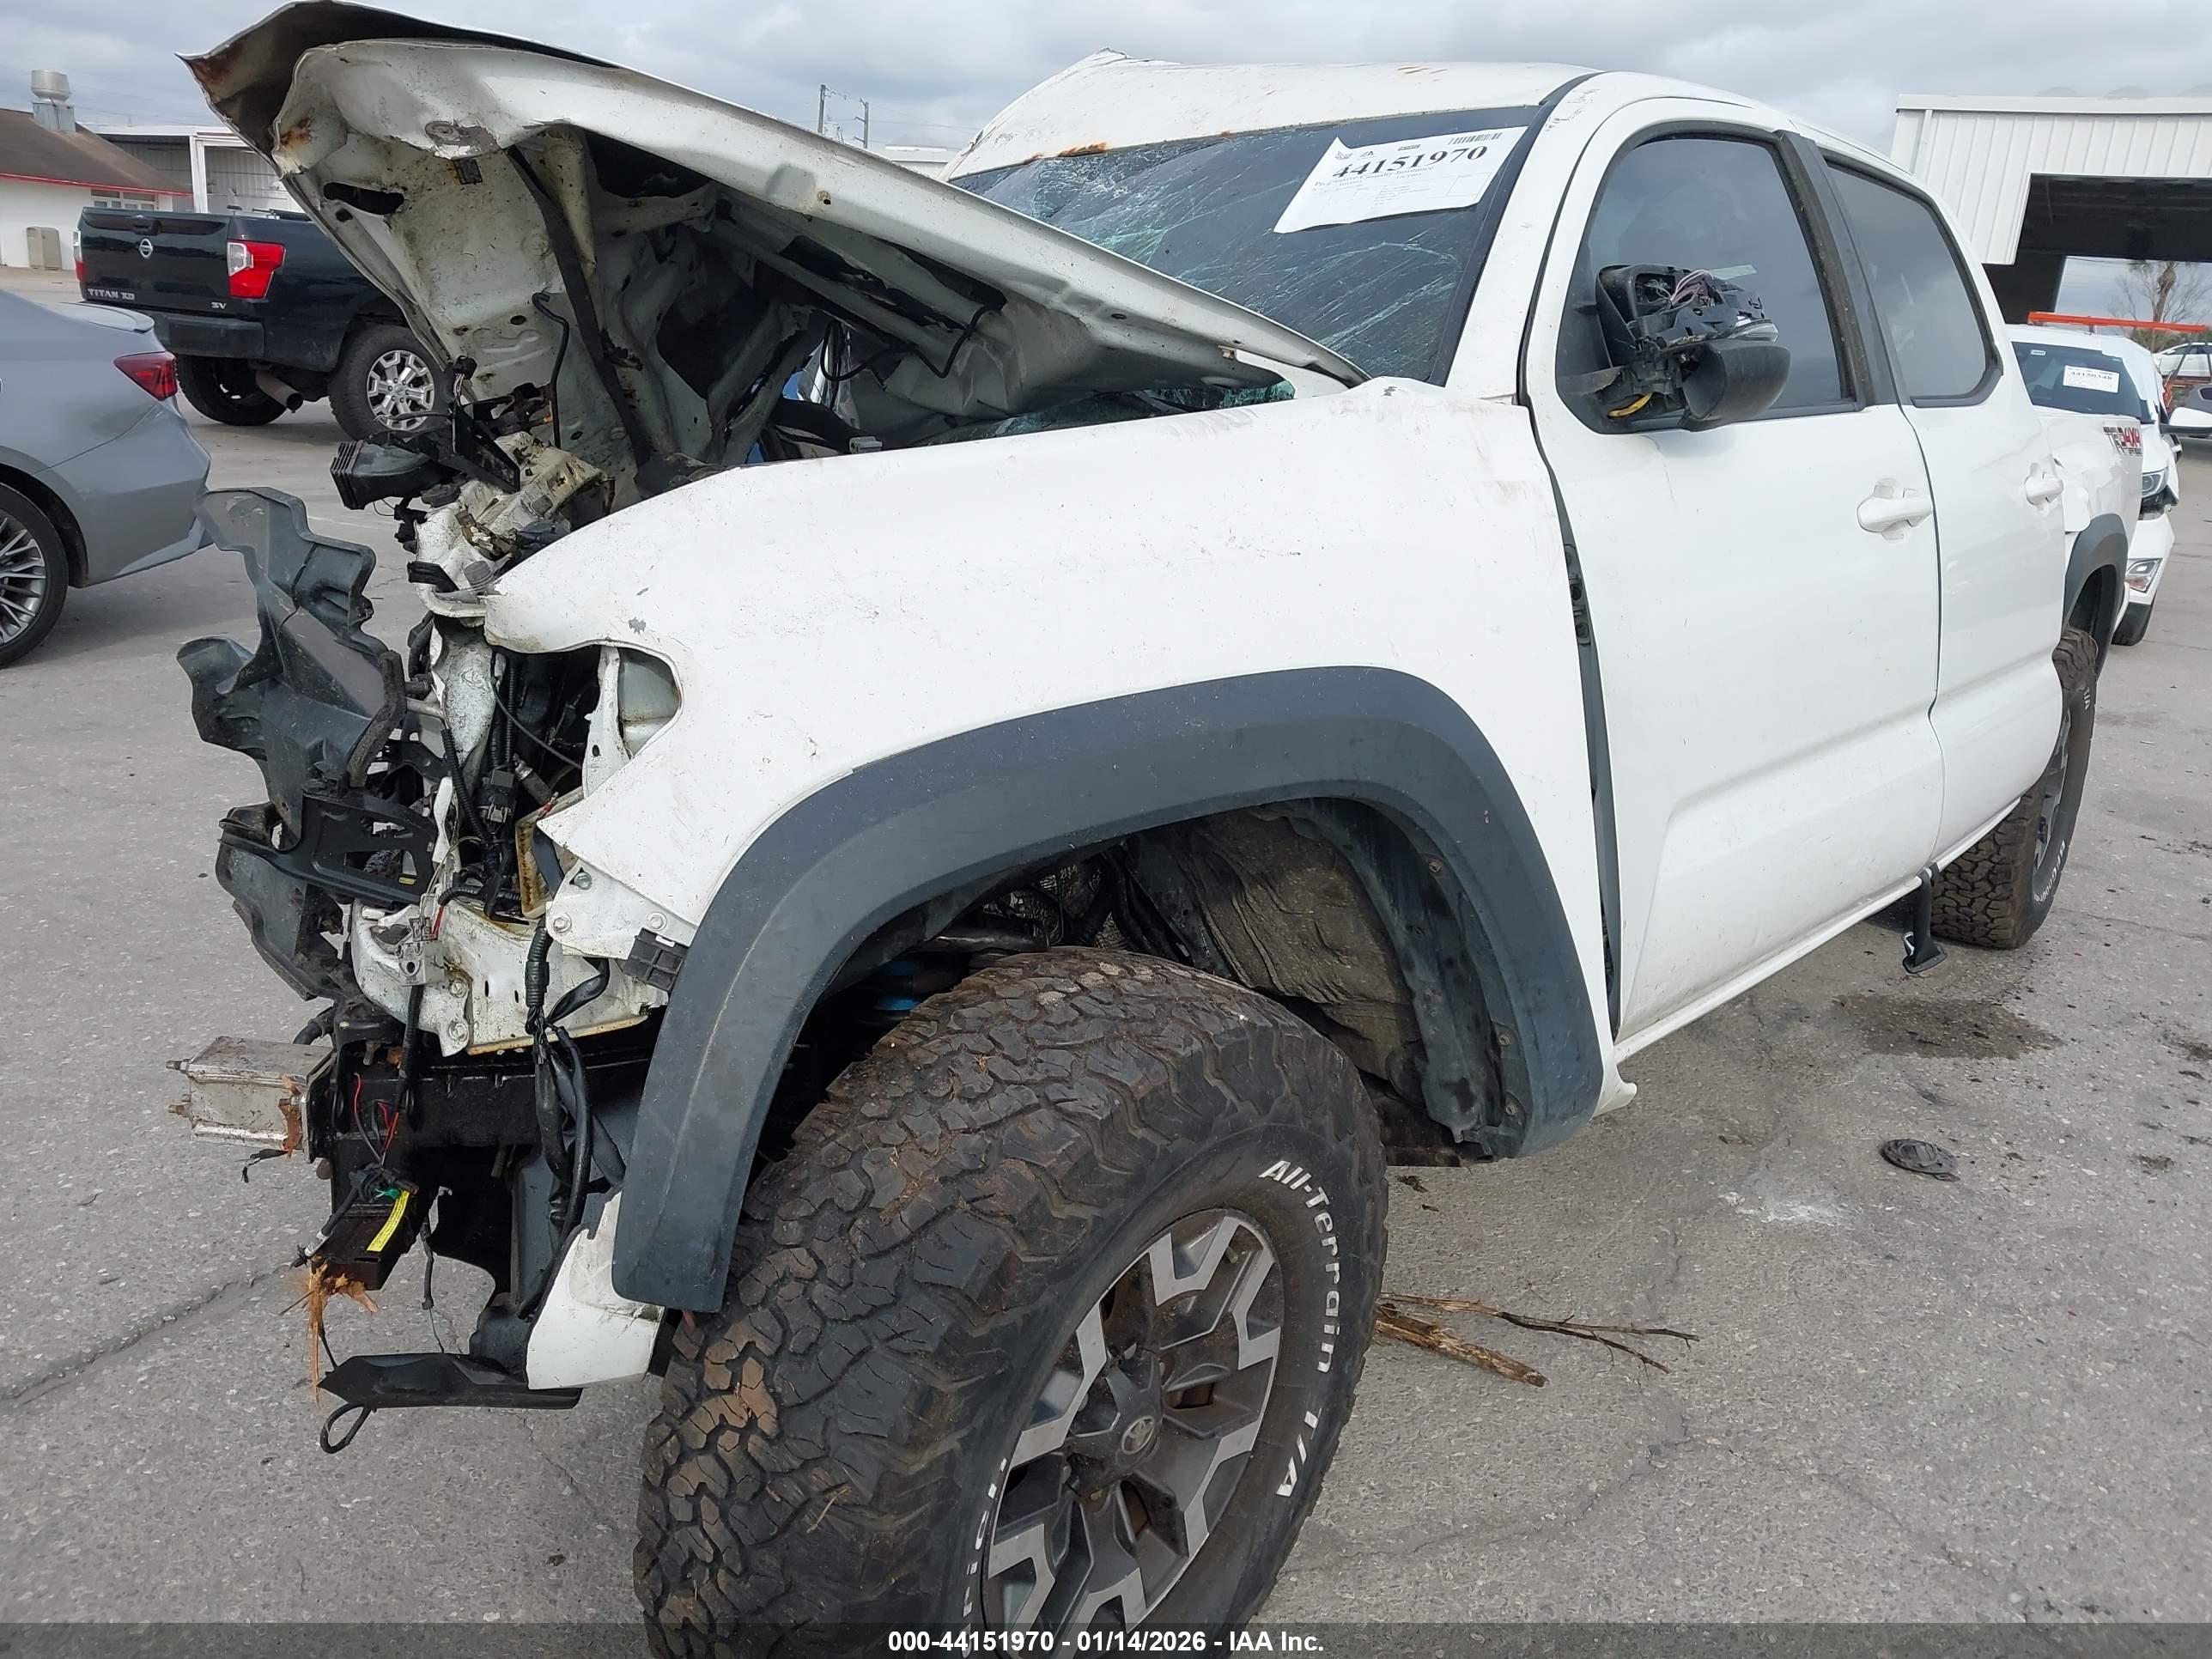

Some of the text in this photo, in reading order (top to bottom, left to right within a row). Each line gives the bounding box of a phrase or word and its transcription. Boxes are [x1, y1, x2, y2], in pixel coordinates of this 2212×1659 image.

[1333, 146, 1487, 178] 44151970
[88, 288, 118, 299] TITAN
[1259, 1161, 1340, 1497] All-Terrain T/A
